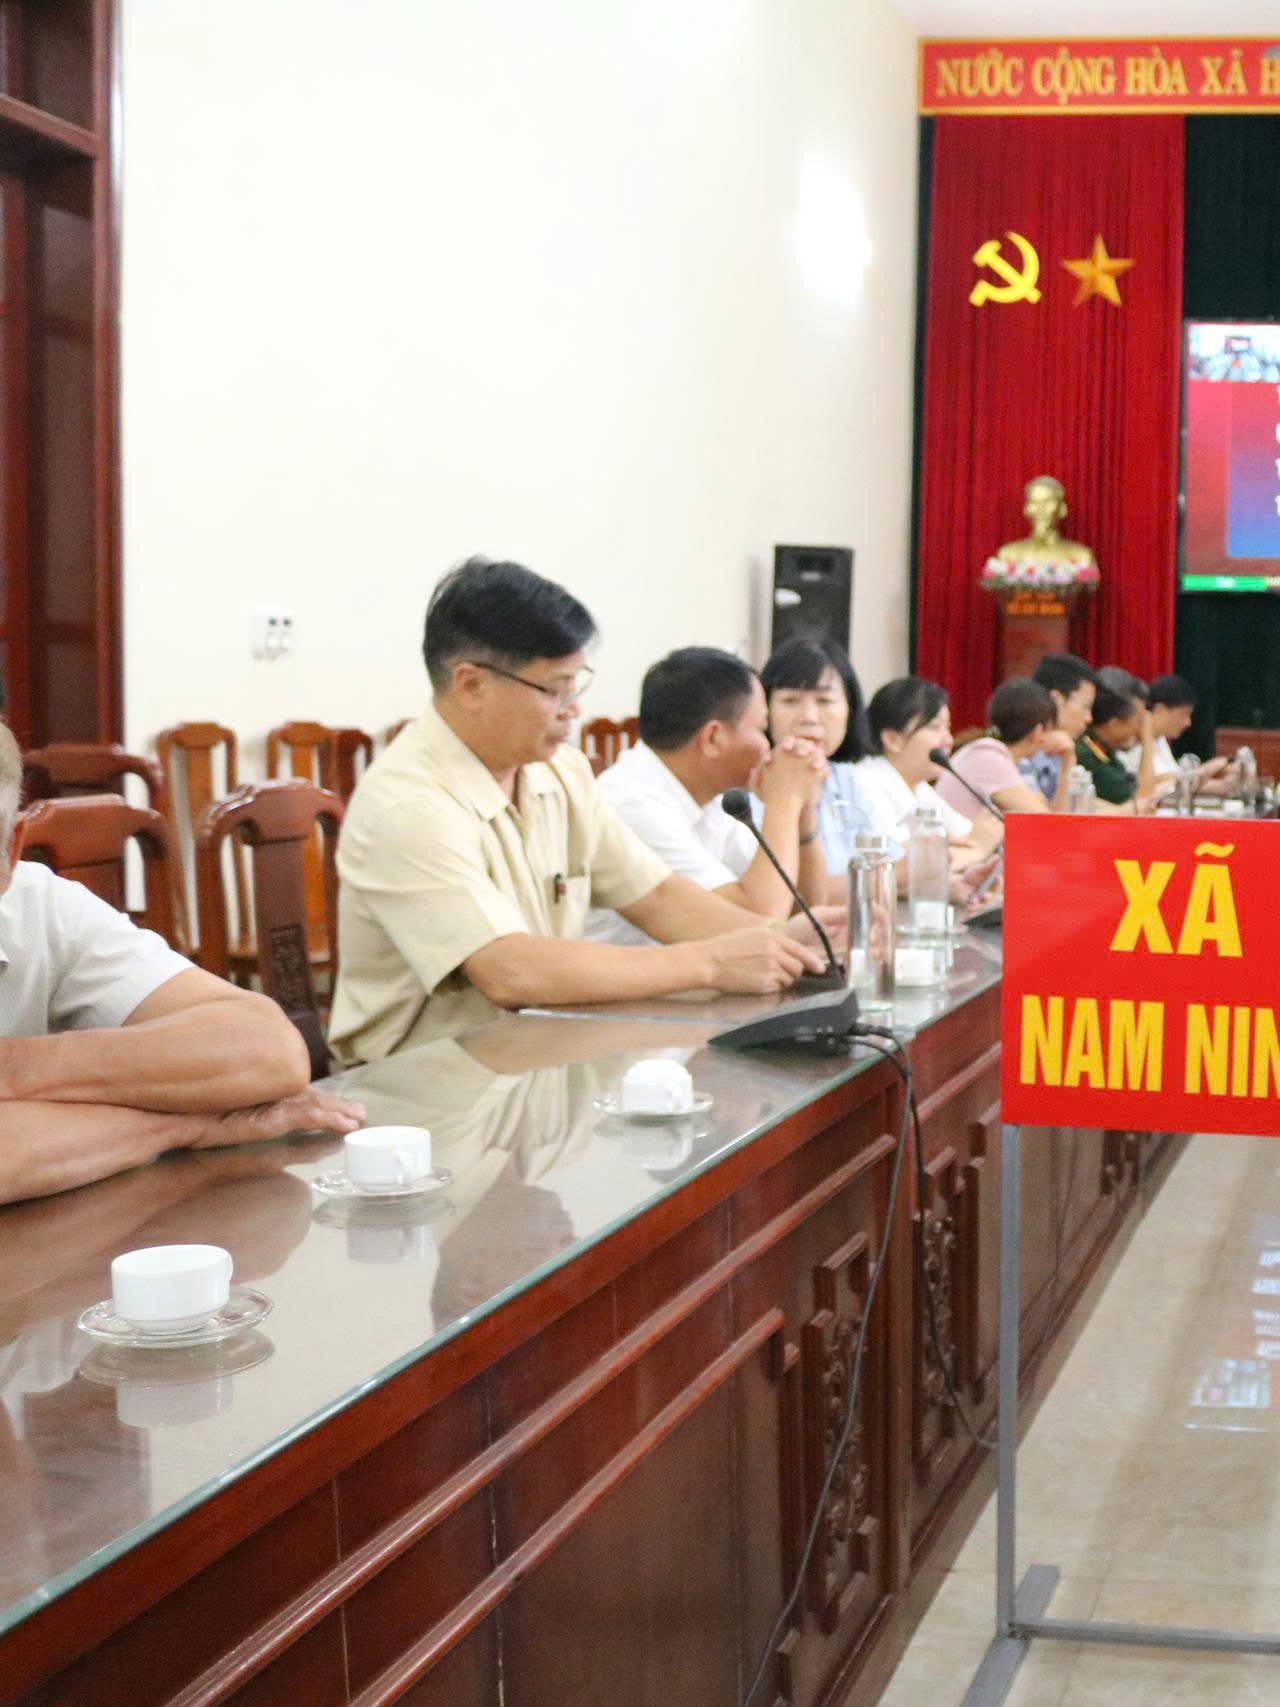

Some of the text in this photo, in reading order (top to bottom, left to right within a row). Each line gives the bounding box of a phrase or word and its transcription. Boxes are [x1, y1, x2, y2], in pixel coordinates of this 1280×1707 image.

[936, 49, 1024, 96] NƯỚC
[1031, 46, 1116, 105] CỘNG
[1125, 46, 1189, 96] HÒA
[1200, 48, 1247, 96] XÃ
[1110, 841, 1243, 958] XÃ
[1020, 994, 1165, 1092] NAM
